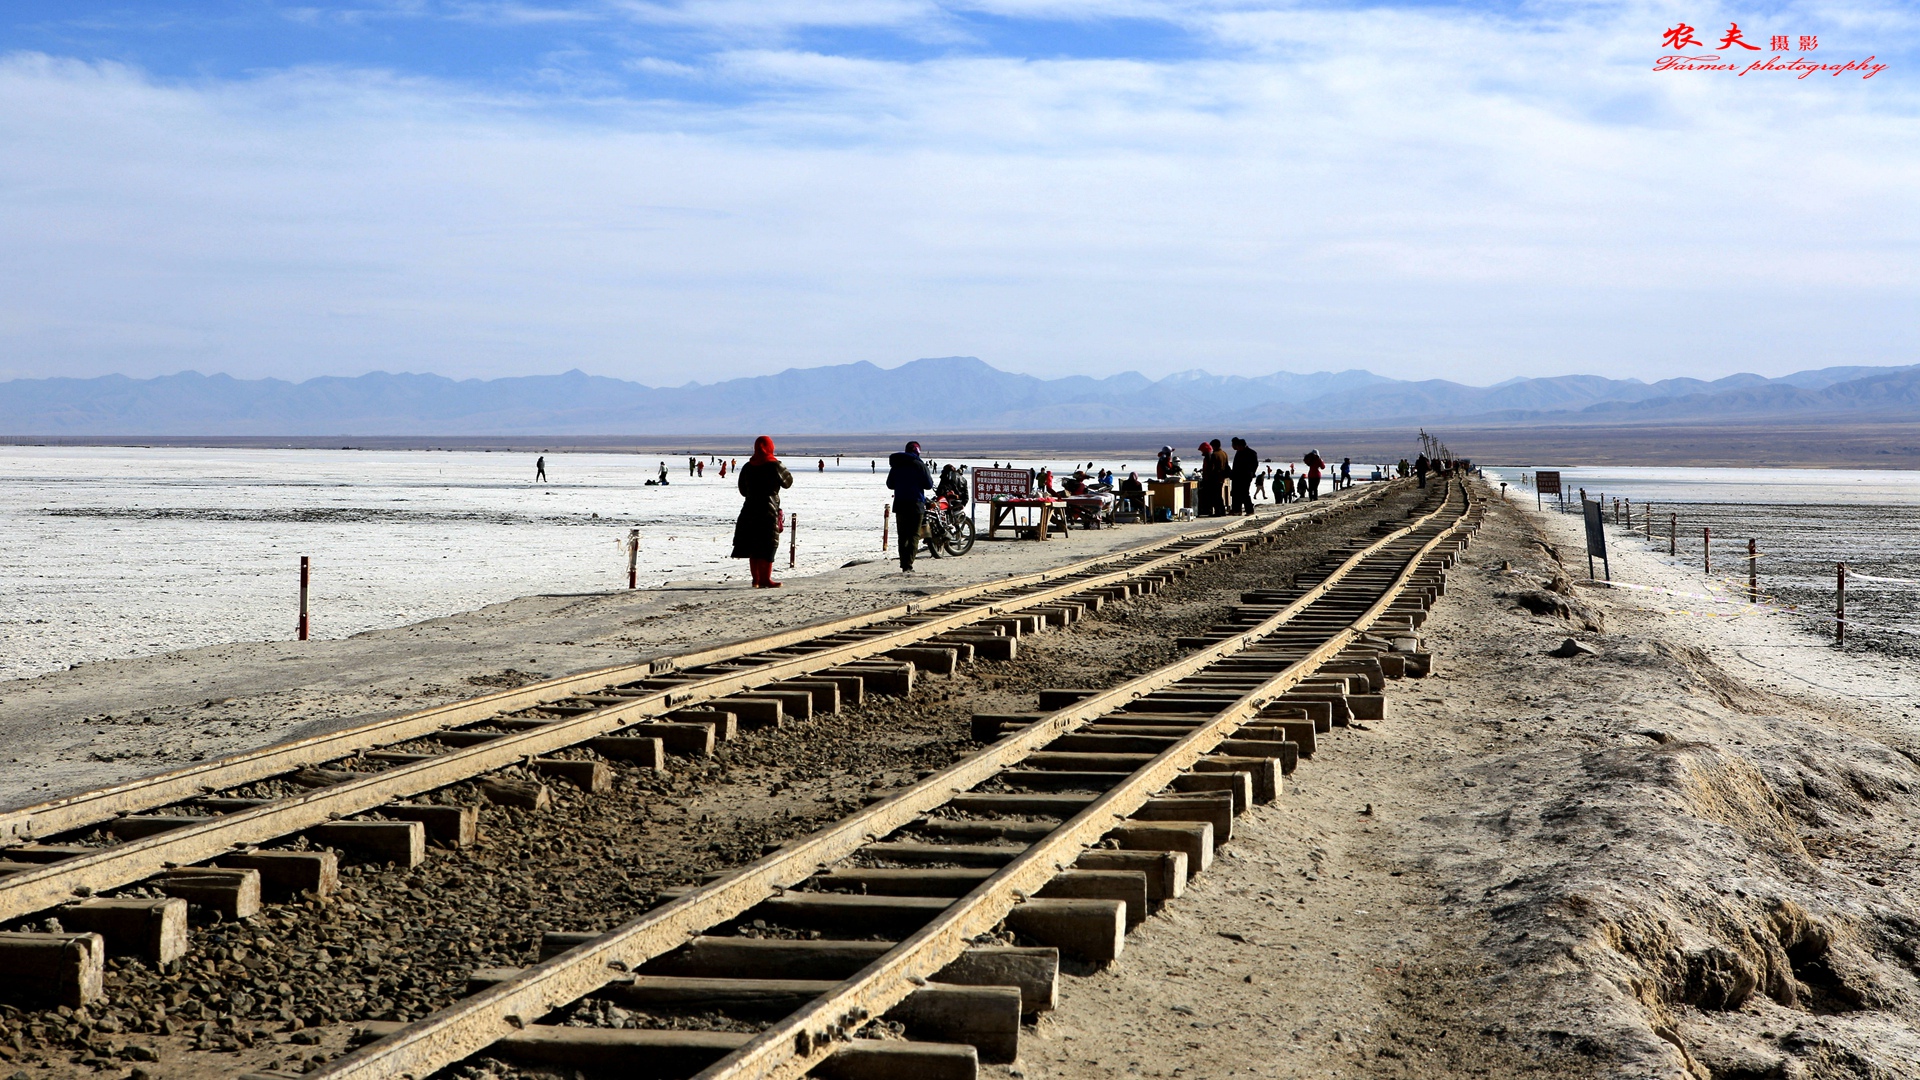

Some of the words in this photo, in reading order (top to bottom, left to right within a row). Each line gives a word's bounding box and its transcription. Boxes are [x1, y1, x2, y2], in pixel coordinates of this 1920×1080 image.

[978, 484, 1026, 493] 保护盐湖环境
